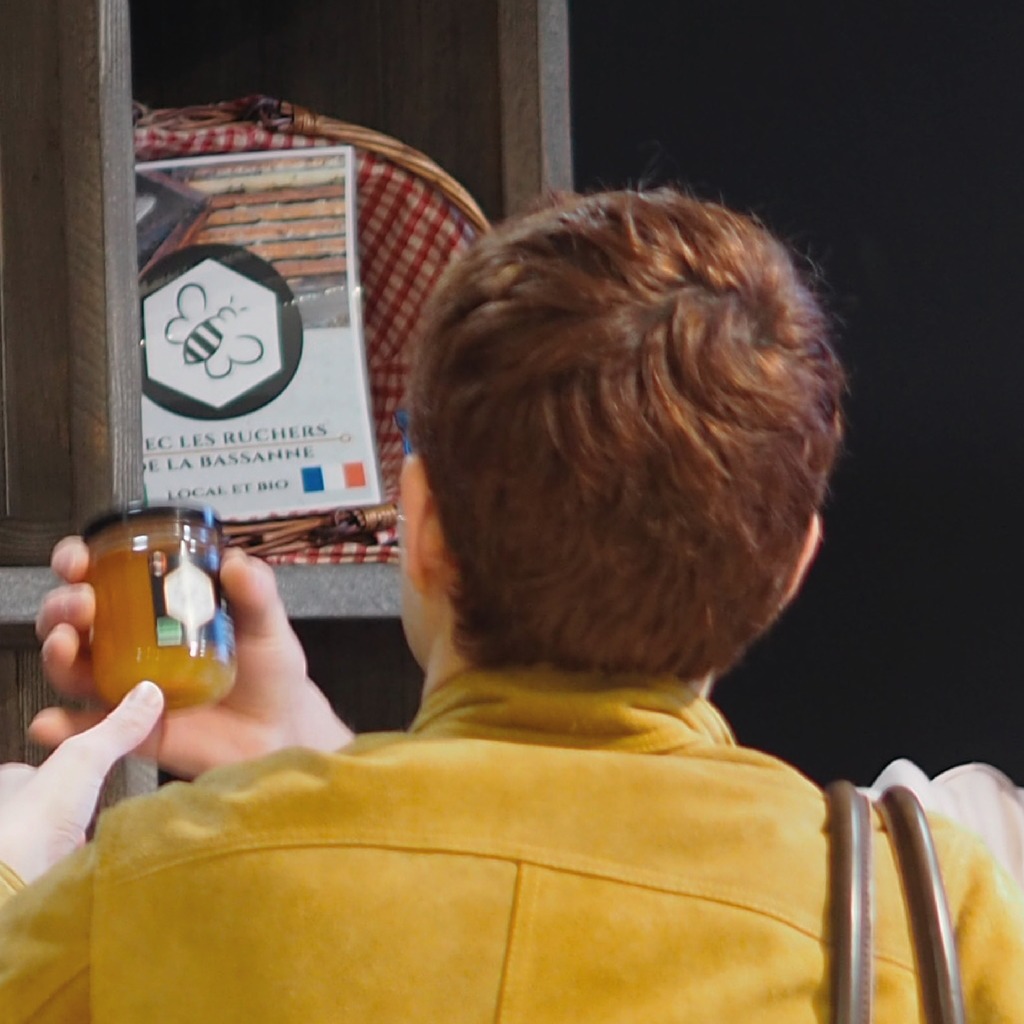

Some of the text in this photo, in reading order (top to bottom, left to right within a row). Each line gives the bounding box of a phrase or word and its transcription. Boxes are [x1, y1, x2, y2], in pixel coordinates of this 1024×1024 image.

[145, 424, 328, 450] EC LES RUCHERS
[167, 457, 193, 471] LA
[200, 447, 315, 468] BASSANNE
[167, 479, 289, 500] LOCAL ET BIO
